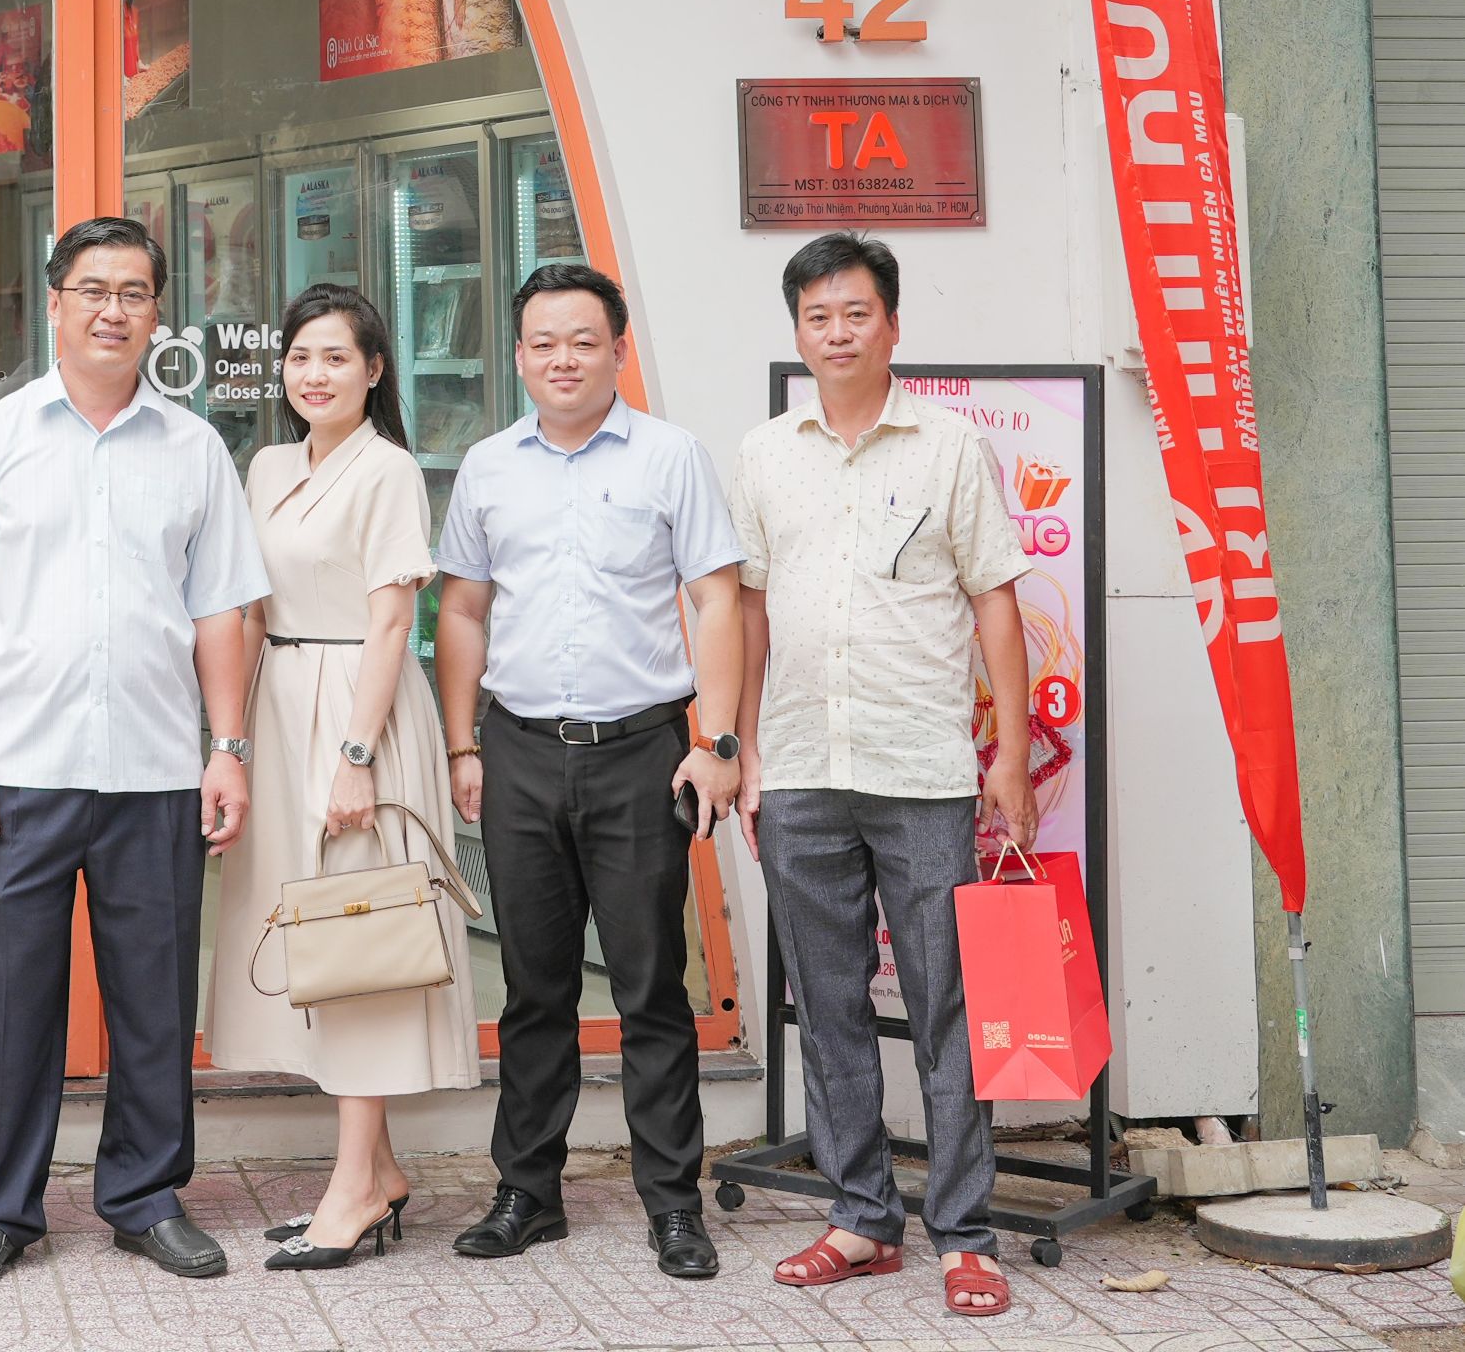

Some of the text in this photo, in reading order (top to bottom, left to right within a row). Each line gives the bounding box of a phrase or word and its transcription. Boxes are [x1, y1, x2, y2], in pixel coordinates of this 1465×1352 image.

[751, 94, 783, 107] CÔNG
[786, 95, 800, 107] TY
[803, 95, 835, 107] TNHH
[889, 95, 910, 109] MẠI
[913, 95, 920, 105] &
[923, 94, 950, 108] DỊCH
[952, 94, 968, 107] VỤ
[1189, 91, 1208, 144] MAU
[809, 111, 908, 170] TA
[1195, 152, 1214, 183] CÀ
[307, 180, 330, 191] ALASKA
[795, 178, 915, 191] MST: 0316382482
[774, 203, 785, 215] 42
[787, 203, 804, 217] Ngô
[950, 201, 969, 213] HCM
[1203, 190, 1226, 262] NHIÊN
[1214, 269, 1236, 337] THIÊN
[217, 324, 283, 350] Welc
[215, 359, 282, 378] Open 8
[215, 383, 283, 399] Close 20
[1009, 514, 1071, 557] NG
[1047, 681, 1066, 719] 3
